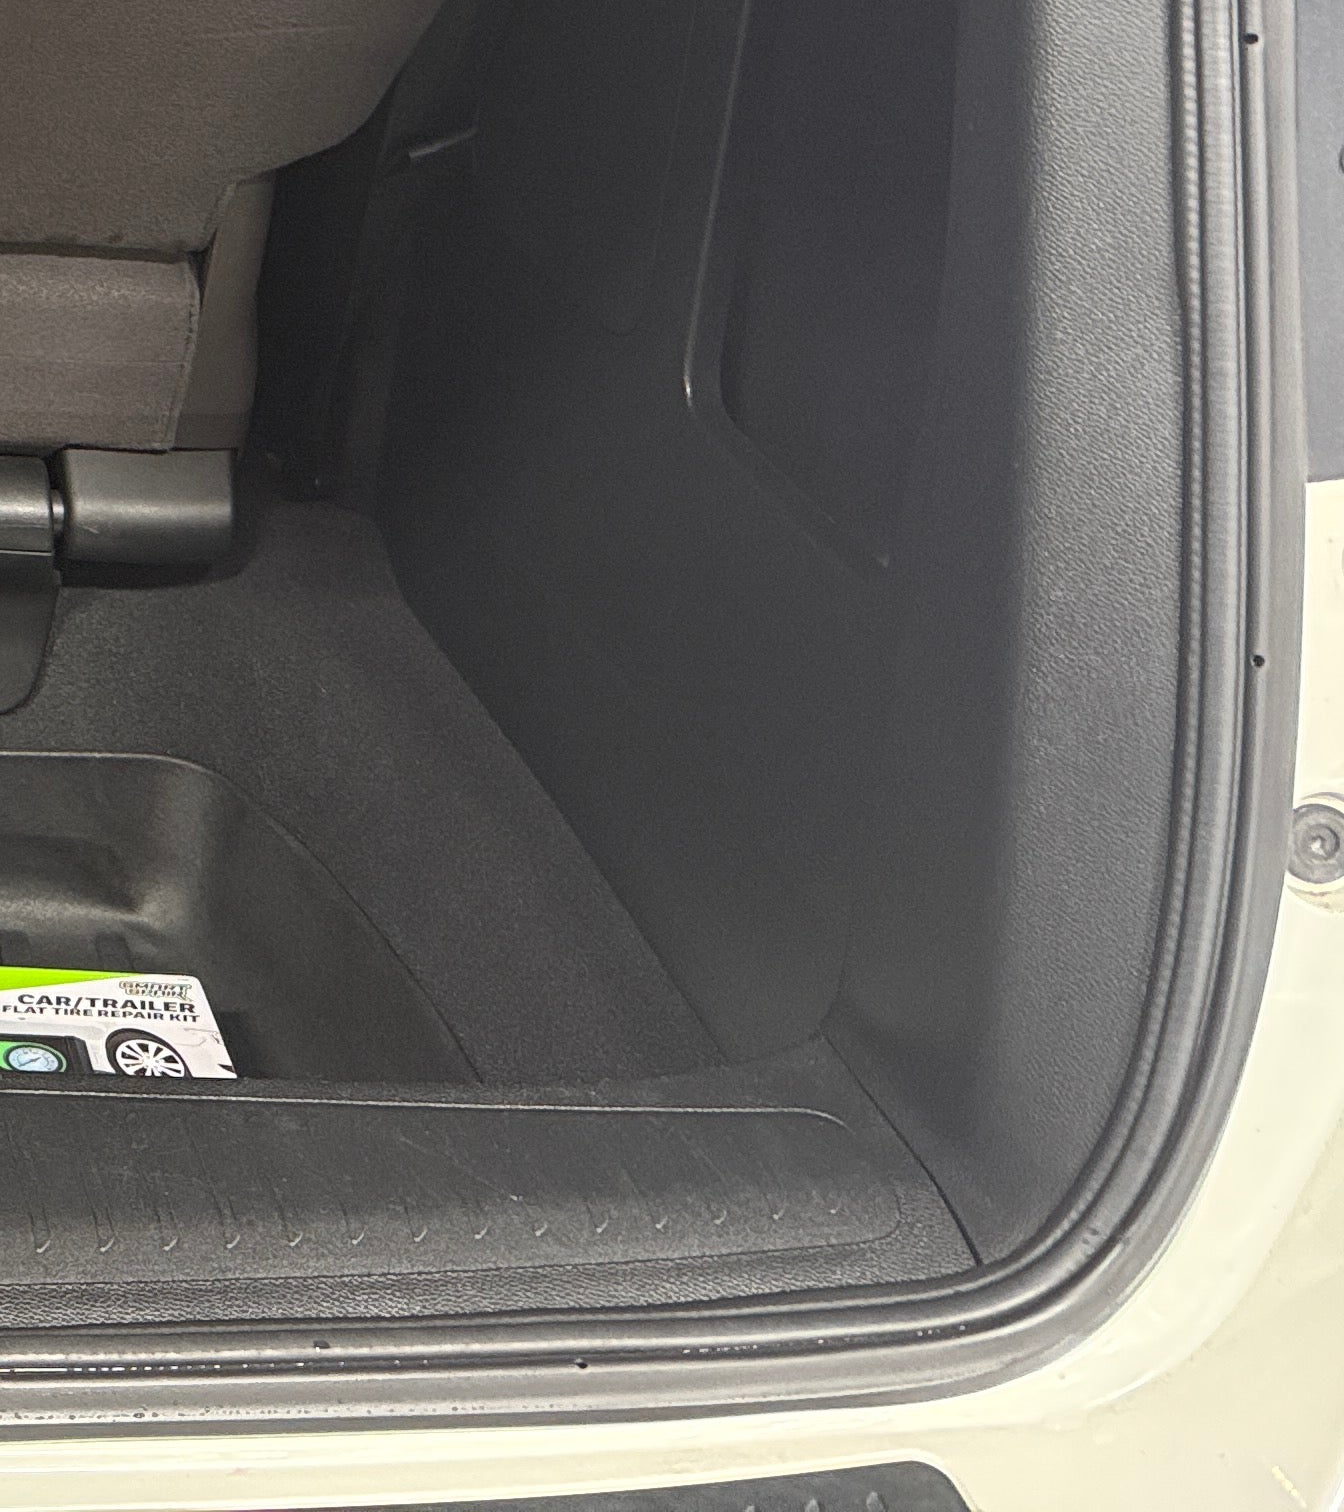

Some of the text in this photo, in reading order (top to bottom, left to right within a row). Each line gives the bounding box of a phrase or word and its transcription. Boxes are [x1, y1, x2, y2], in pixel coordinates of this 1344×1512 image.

[18, 994, 196, 1013] CAR/TRAILER
[2, 1005, 201, 1023] FLAT TIRE REPAIR KIT
